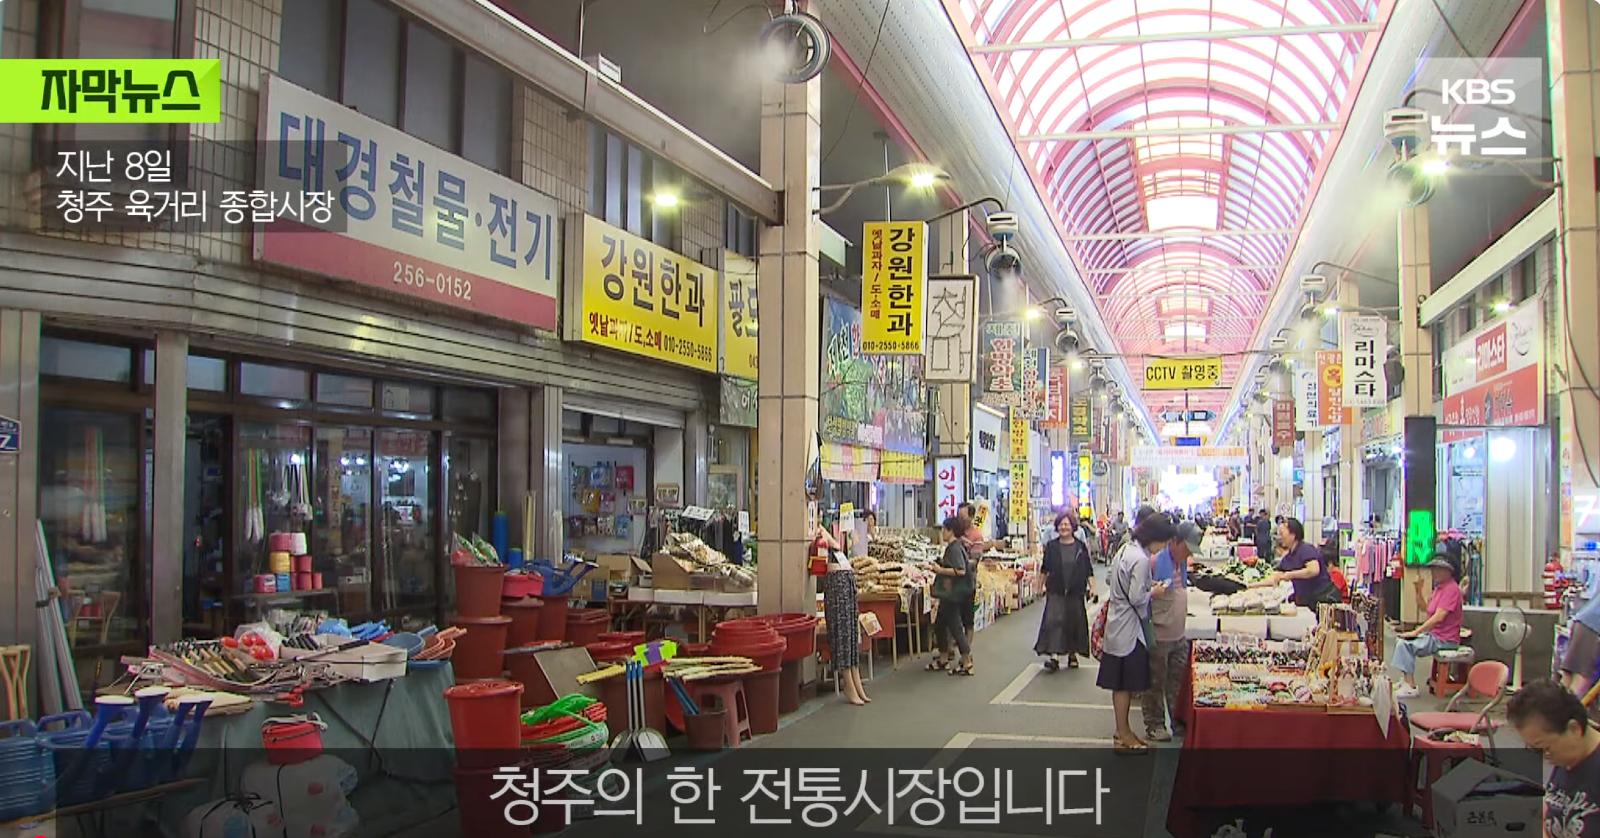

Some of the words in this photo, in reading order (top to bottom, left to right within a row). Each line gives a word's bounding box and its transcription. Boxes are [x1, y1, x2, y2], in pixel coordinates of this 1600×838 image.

[393, 261, 472, 301] 256-0152
[601, 234, 705, 328] 강원한과
[887, 227, 915, 337] 강원한과
[663, 333, 713, 363] 010-2550-5866
[862, 340, 920, 350] 010-2550-5866
[1146, 365, 1177, 381] CCTV
[1181, 364, 1219, 381] 촬영중
[1354, 340, 1376, 397] 리마스타
